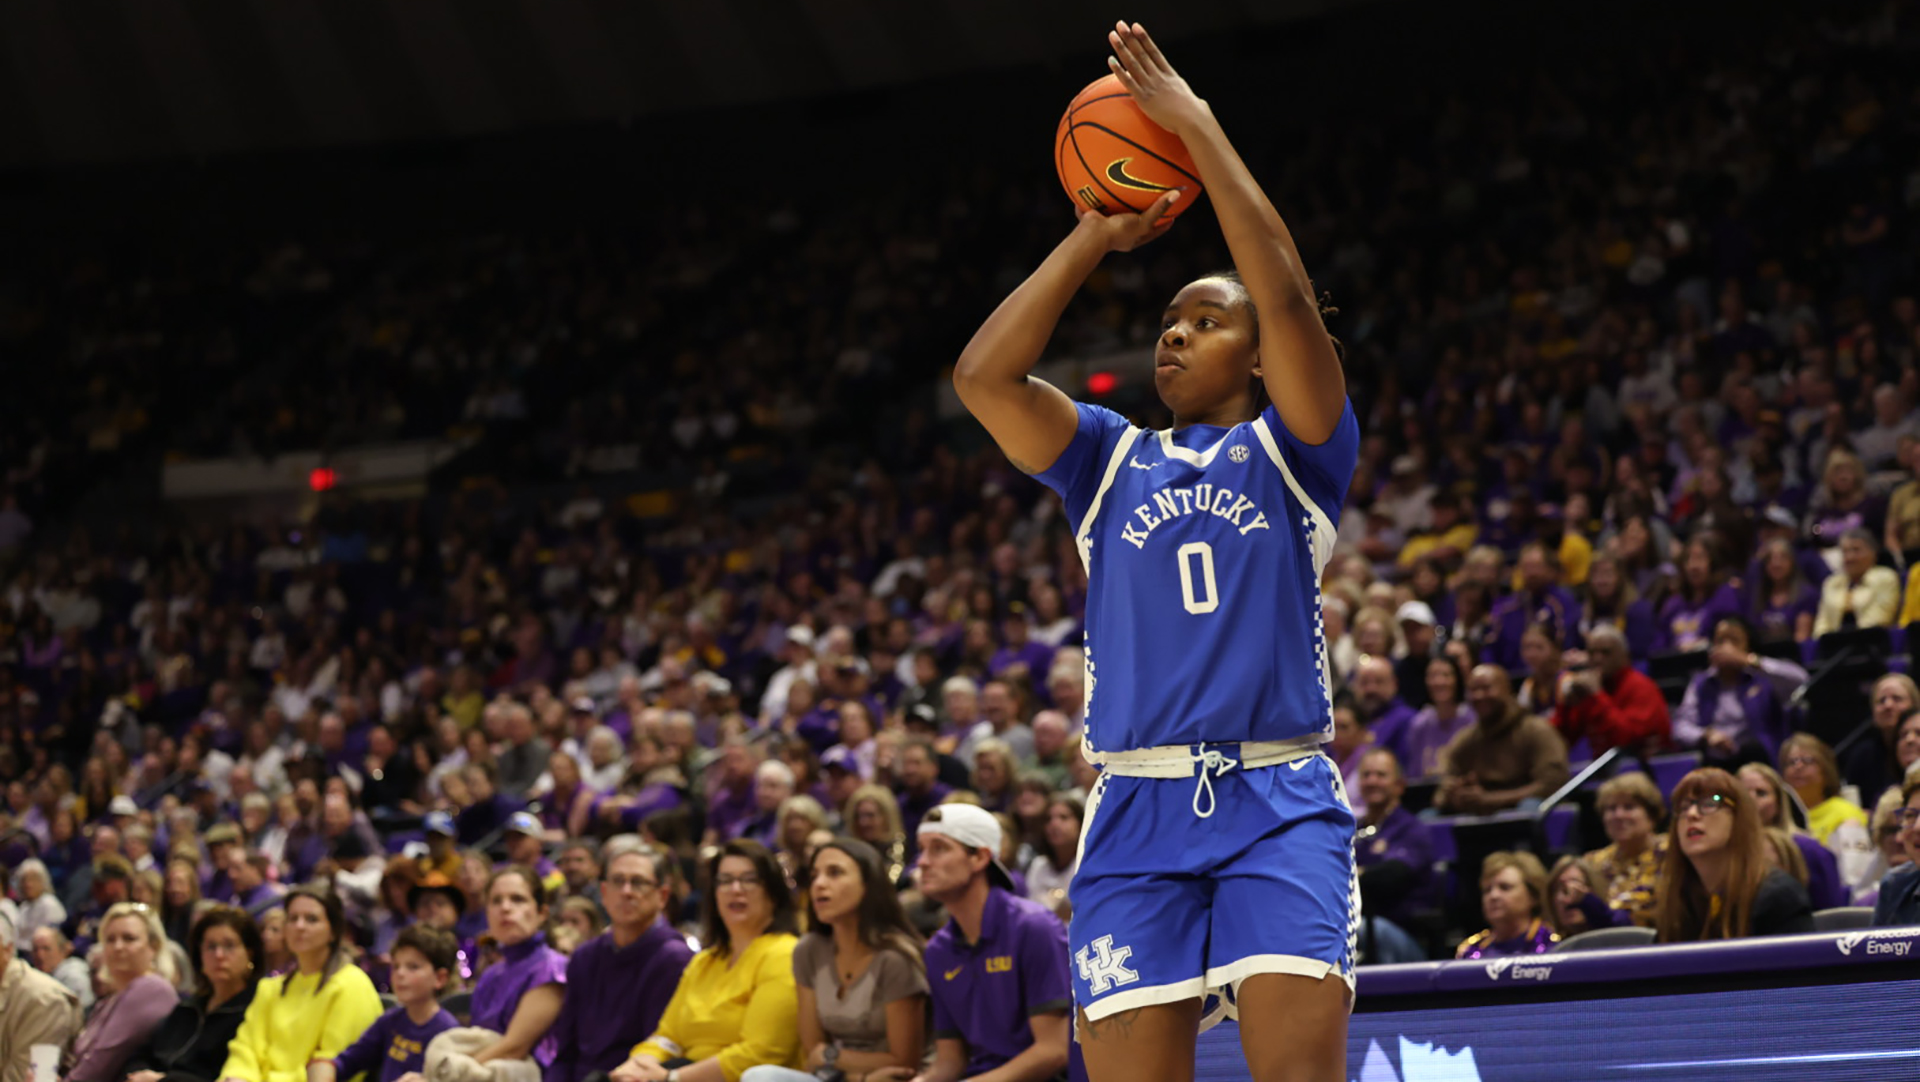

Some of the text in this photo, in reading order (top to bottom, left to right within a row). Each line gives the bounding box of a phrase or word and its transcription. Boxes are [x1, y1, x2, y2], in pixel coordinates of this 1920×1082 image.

[1229, 445, 1249, 462] SEC
[1121, 484, 1270, 549] KENTUCKY
[1177, 541, 1219, 615] 0
[1866, 940, 1912, 956] Energy
[985, 955, 1012, 973] LSU
[1075, 934, 1139, 997] UK
[1511, 965, 1553, 981] Energy
